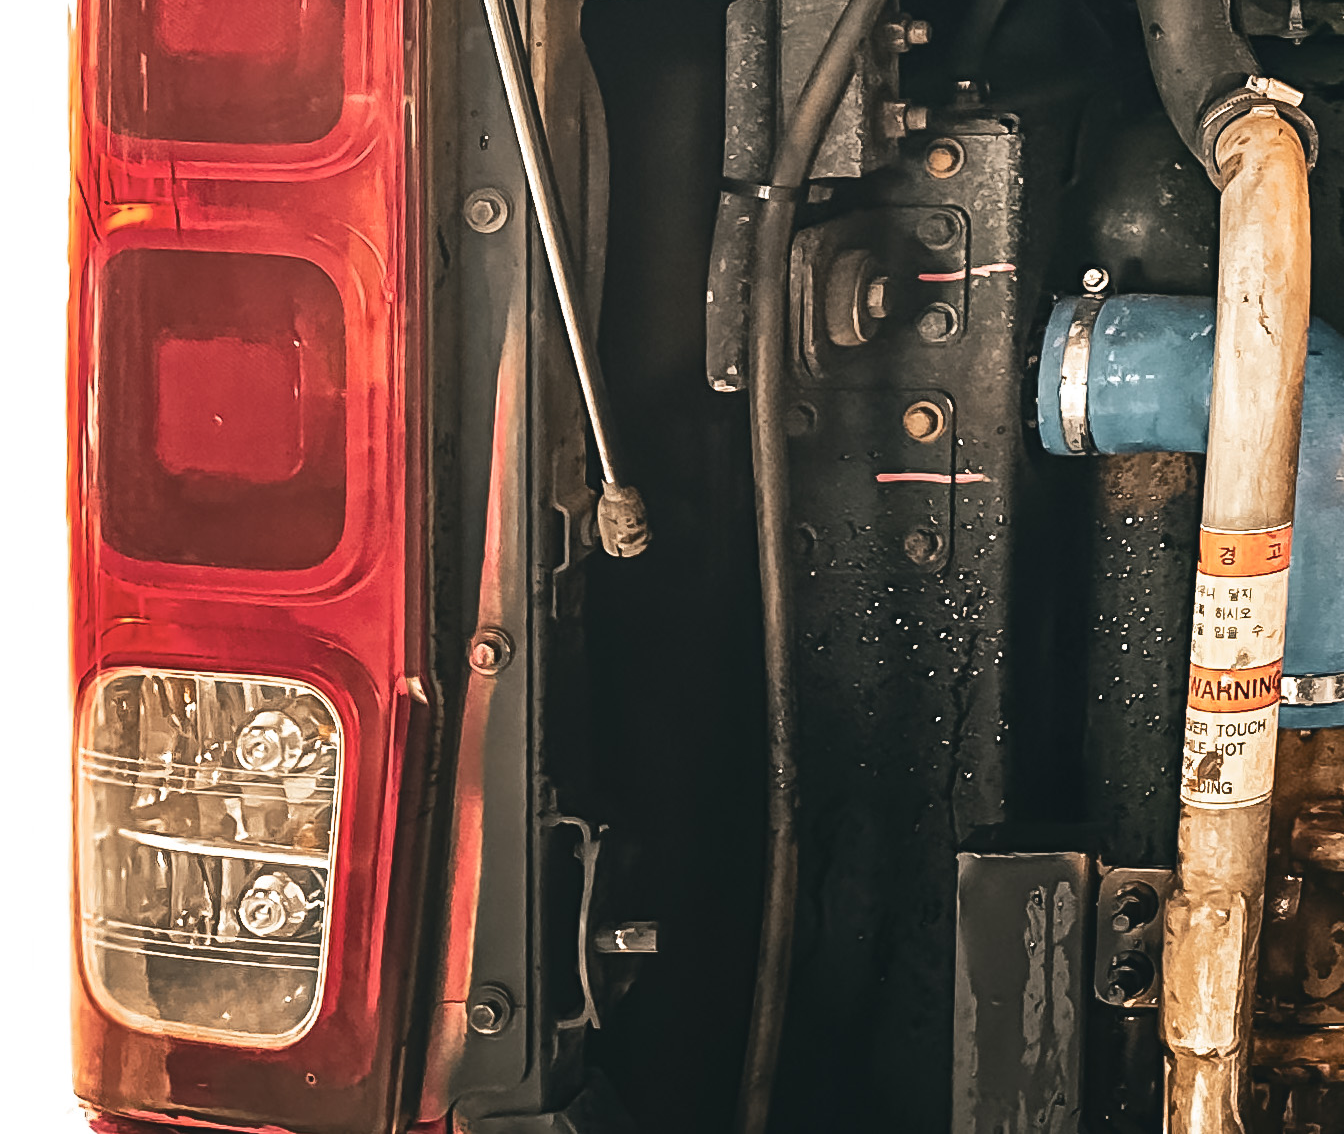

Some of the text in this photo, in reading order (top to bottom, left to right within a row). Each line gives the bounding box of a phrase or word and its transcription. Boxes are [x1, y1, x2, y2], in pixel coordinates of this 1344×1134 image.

[1215, 607, 1252, 621] 하시오
[1214, 626, 1239, 639] 입을
[1252, 624, 1265, 638] 수
[1190, 670, 1282, 701] WARNING
[1216, 718, 1267, 738] TOUCH
[1215, 741, 1247, 757] HOT
